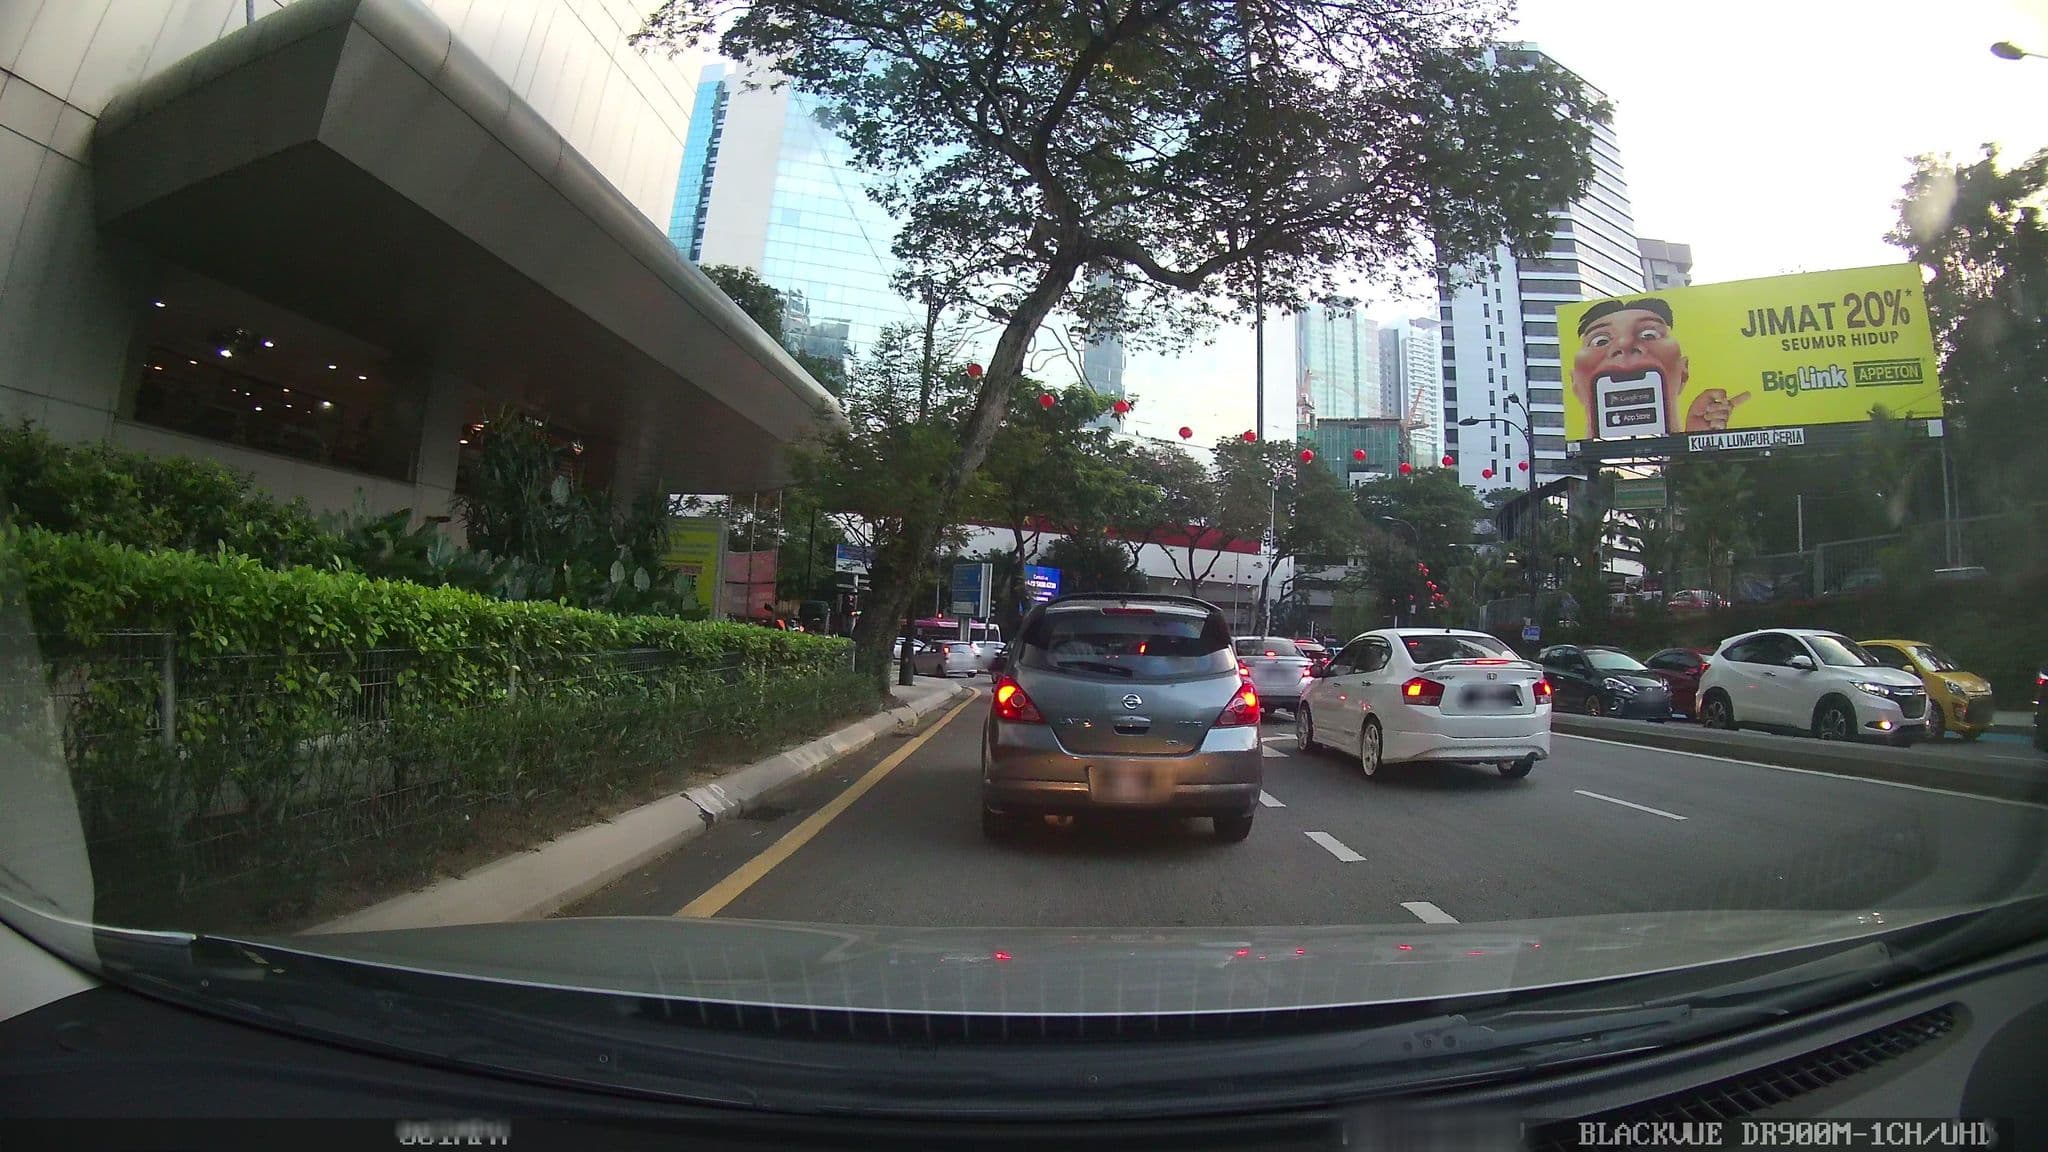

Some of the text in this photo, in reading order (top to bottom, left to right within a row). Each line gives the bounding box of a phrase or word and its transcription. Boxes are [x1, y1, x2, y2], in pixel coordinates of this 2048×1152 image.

[1741, 302, 1836, 338] JIMAT
[1781, 330, 1900, 352] SEUMUR HIDUP
[1761, 363, 1848, 397] BigLink
[1859, 364, 1920, 382] APPETON
[1691, 430, 1803, 450] KUALA LUMPUR CERIA
